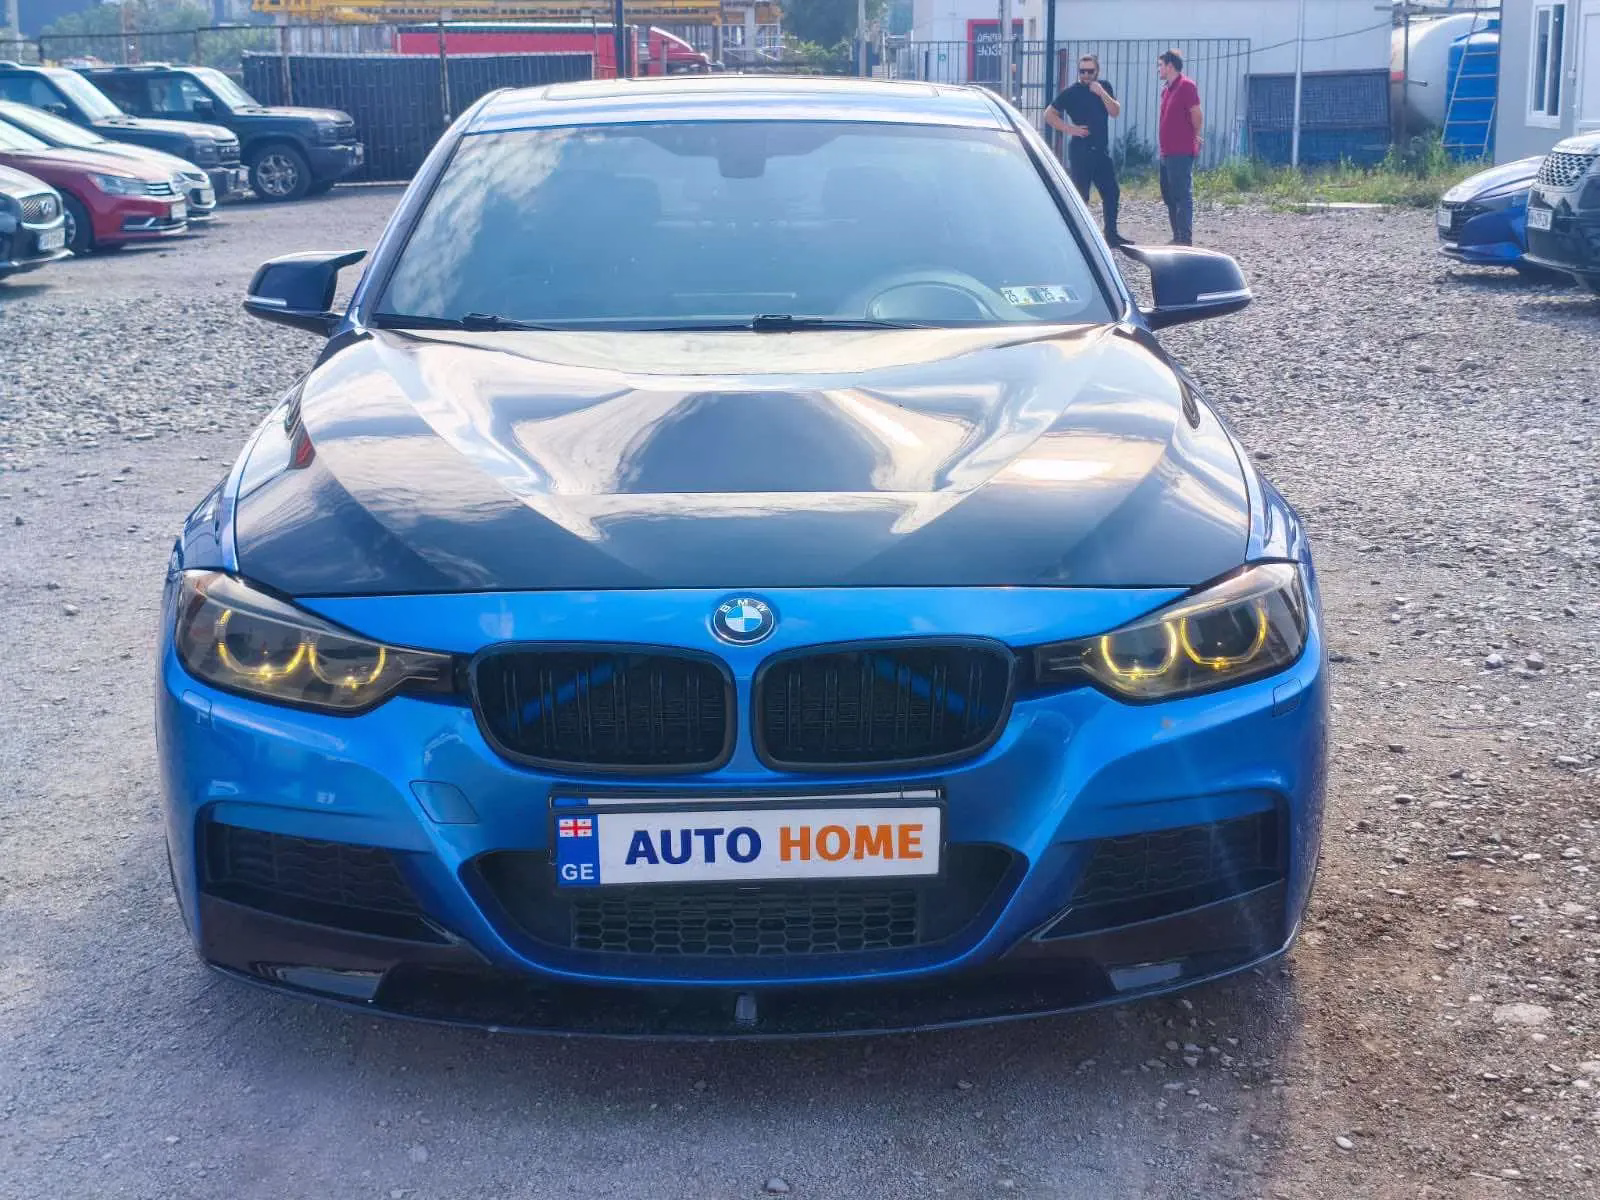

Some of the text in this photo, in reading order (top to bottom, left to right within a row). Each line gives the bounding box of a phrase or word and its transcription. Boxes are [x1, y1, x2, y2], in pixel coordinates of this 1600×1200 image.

[719, 599, 768, 613] BMW
[625, 824, 924, 864] AUTO HOME
[561, 863, 594, 880] GE
